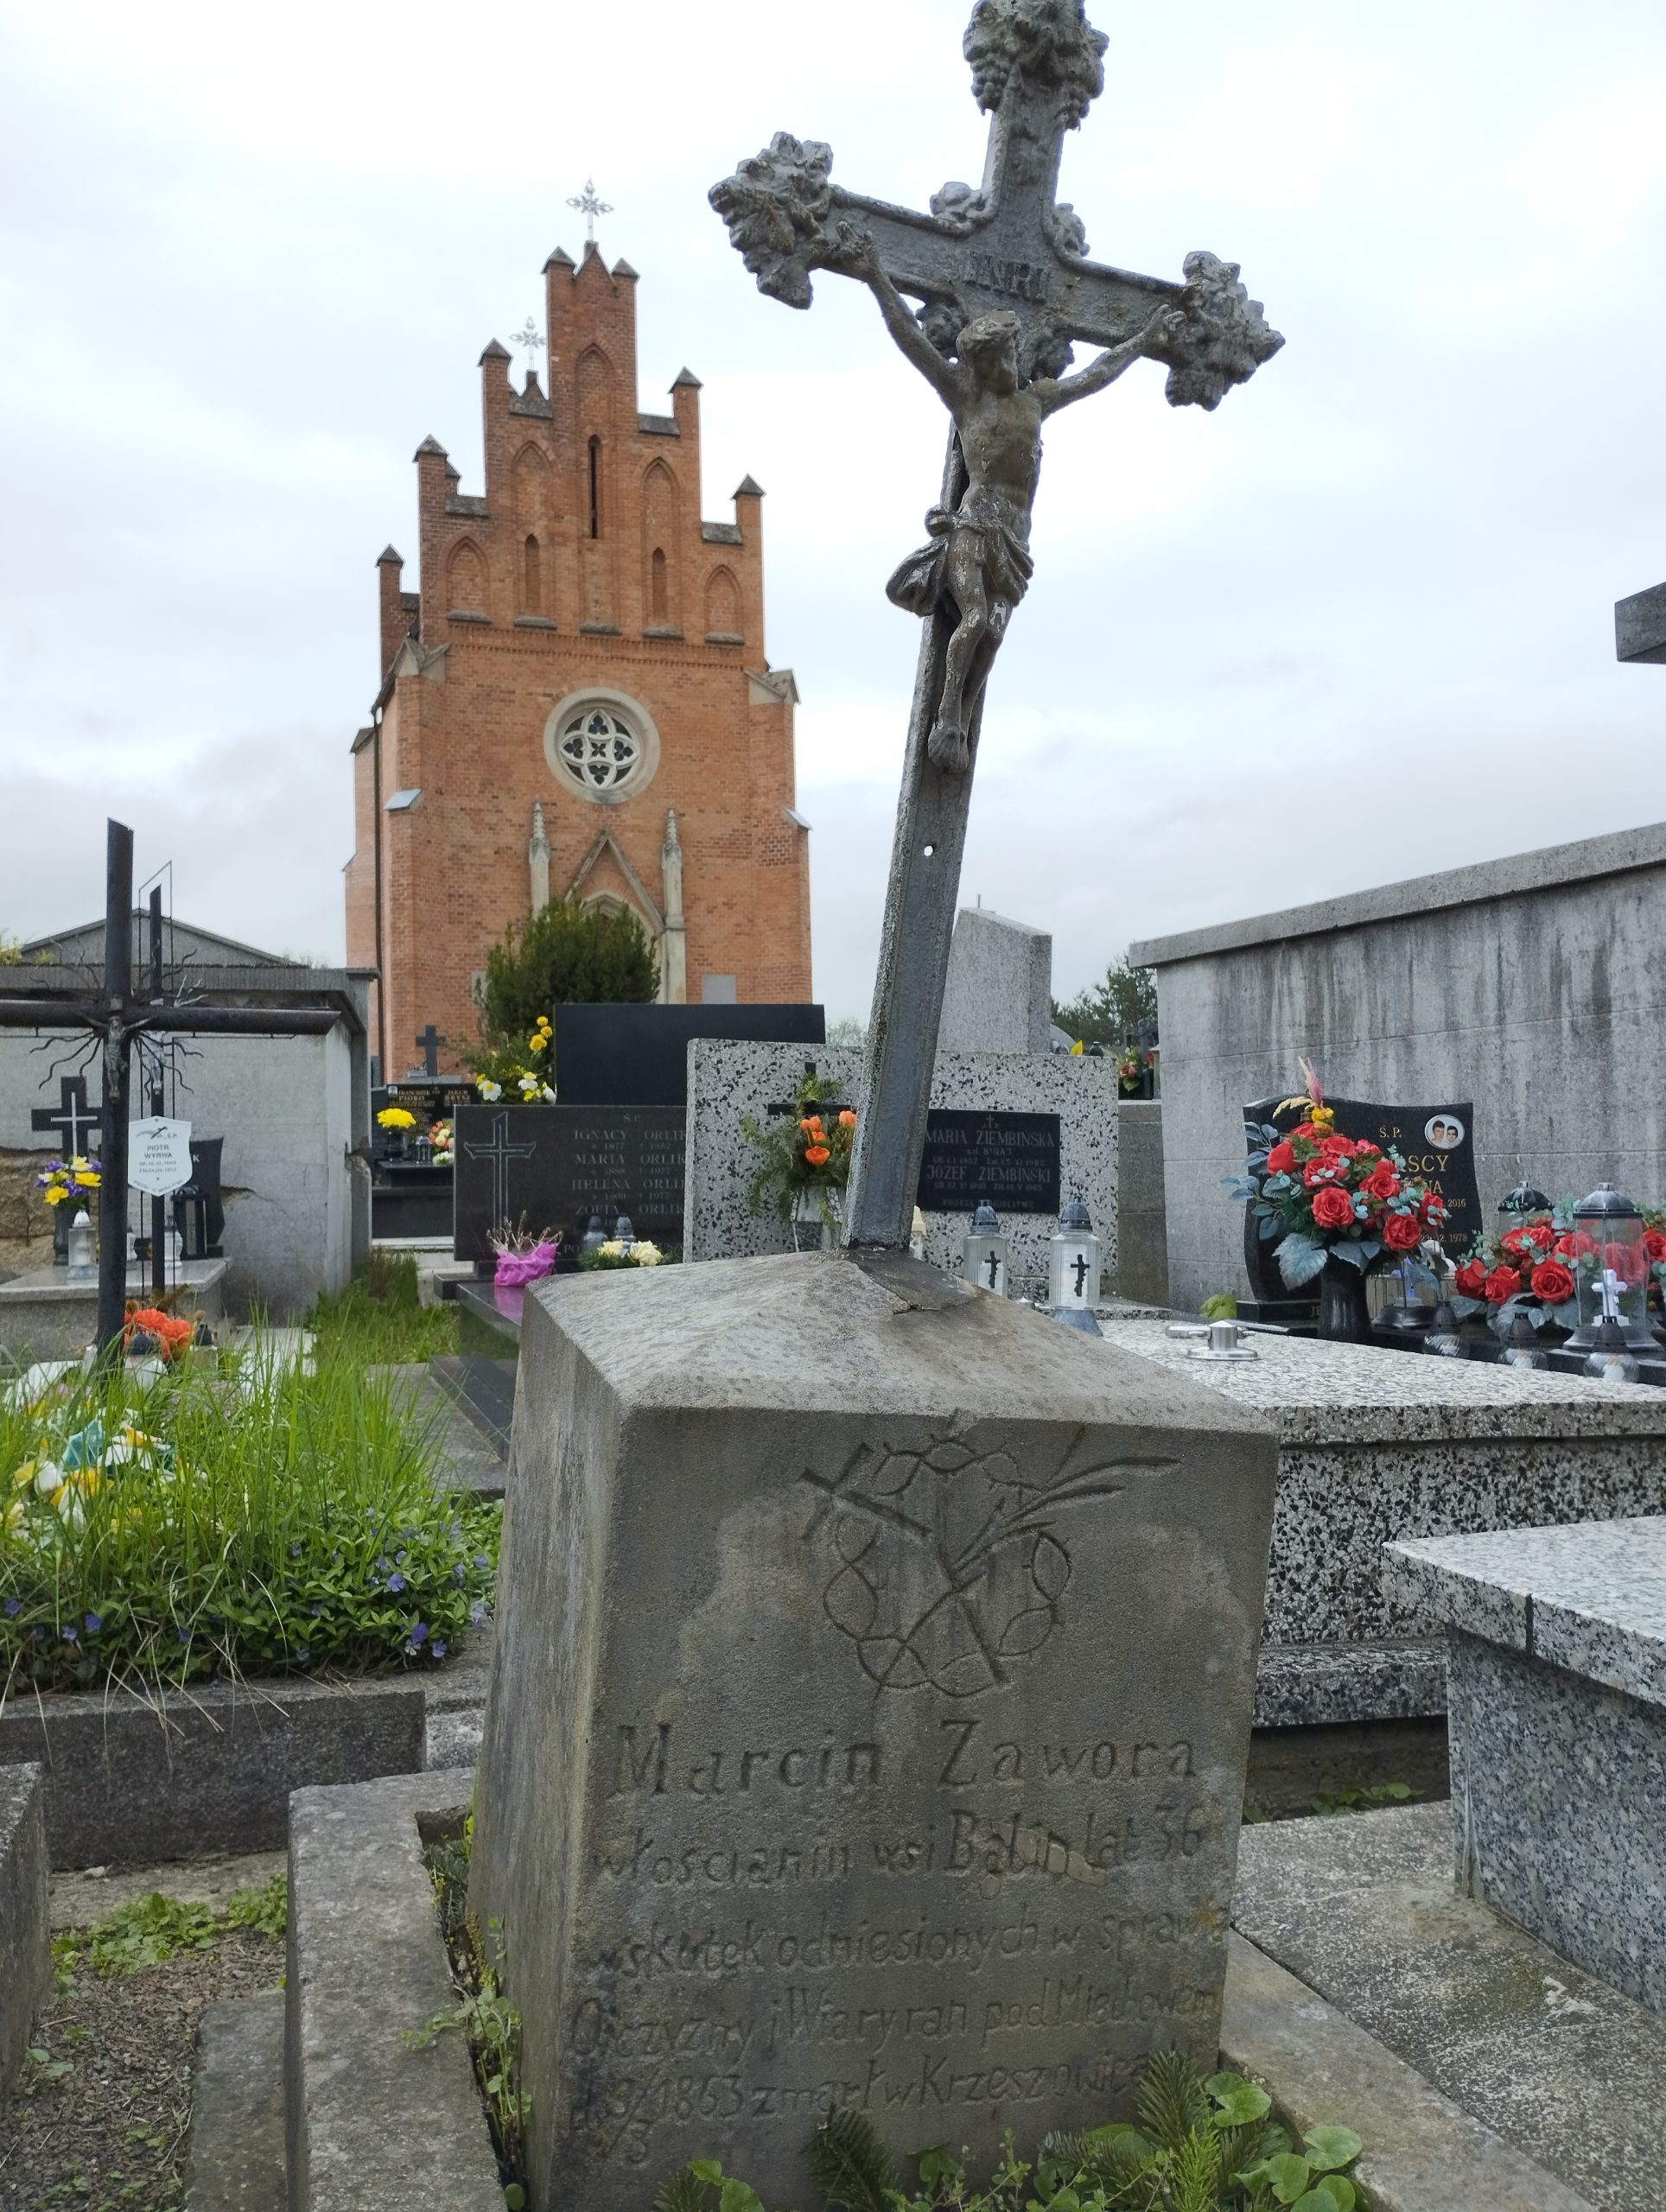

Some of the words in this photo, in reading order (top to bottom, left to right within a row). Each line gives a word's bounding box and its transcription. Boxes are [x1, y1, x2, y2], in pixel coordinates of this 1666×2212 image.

[574, 1129, 628, 1141] IGNACY
[925, 1128, 968, 1145] MARIA
[575, 1154, 625, 1165] MARIA
[640, 1154, 686, 1165] ORLIK
[571, 1179, 631, 1190] HELENA
[575, 1204, 620, 1215] ZOFIA
[608, 1721, 882, 1796] Marcin
[937, 1719, 1198, 1787] Zawora
[776, 1905, 1039, 1974] odniesionych
[786, 1985, 897, 2056] Wiary
[982, 1975, 1047, 2051] pod
